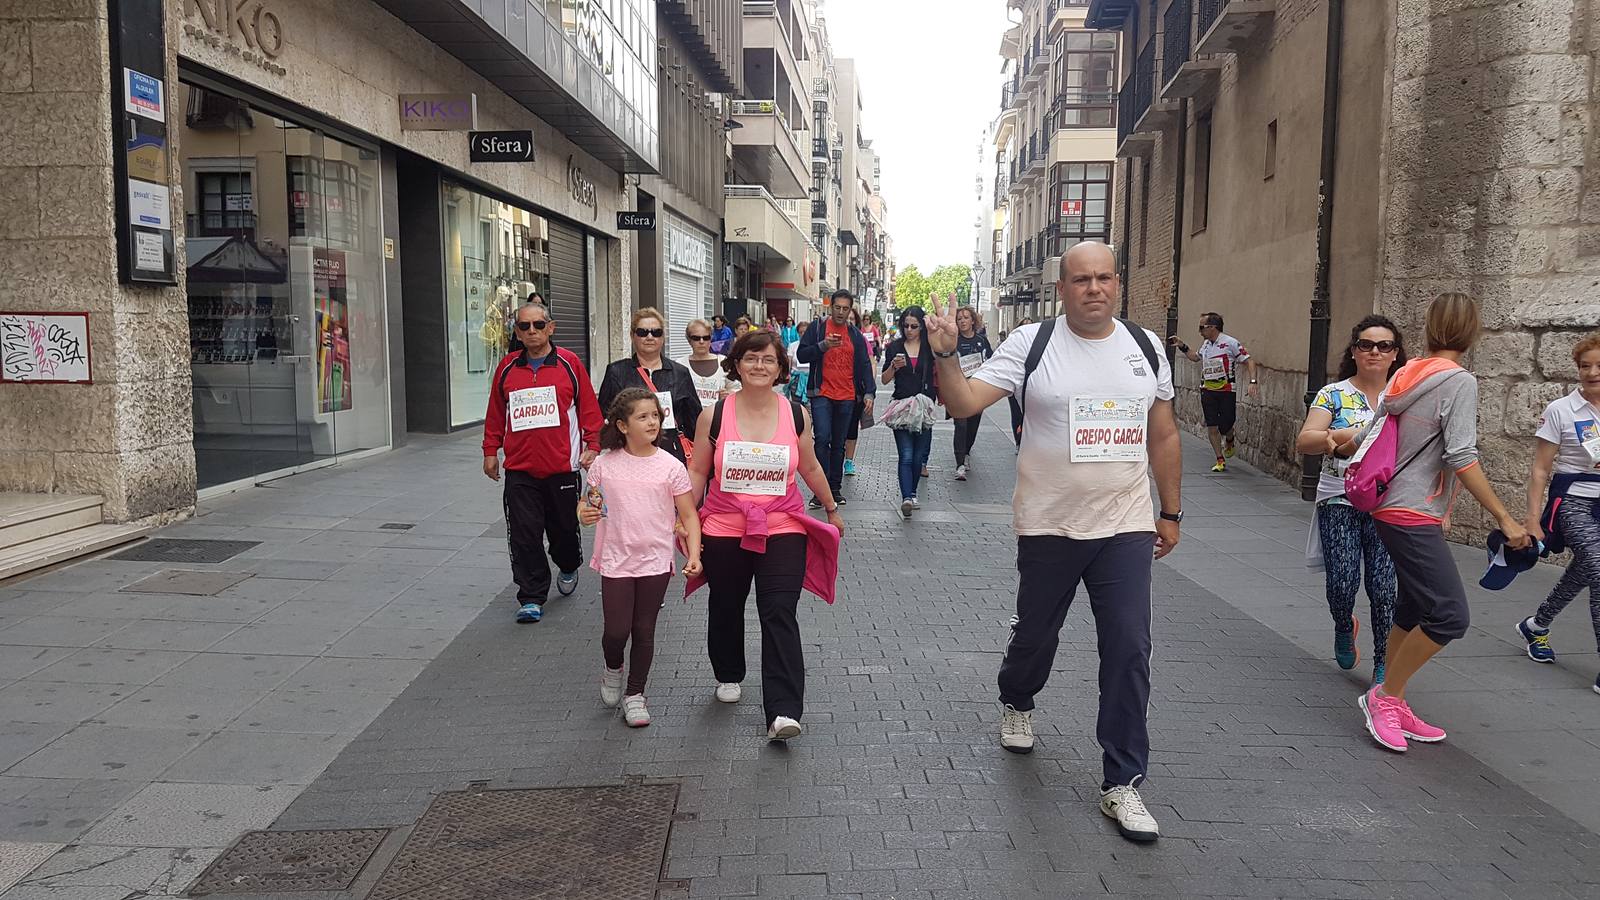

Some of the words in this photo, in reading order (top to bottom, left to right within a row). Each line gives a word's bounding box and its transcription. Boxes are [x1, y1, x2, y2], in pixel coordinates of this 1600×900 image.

[404, 101, 468, 118] KIKO
[513, 403, 556, 419] CARBAJO
[1076, 428, 1112, 445] CRESPO
[1113, 424, 1144, 445] GARCÍA
[725, 467, 755, 481] CRESPO
[755, 467, 785, 482] GARCÍA
